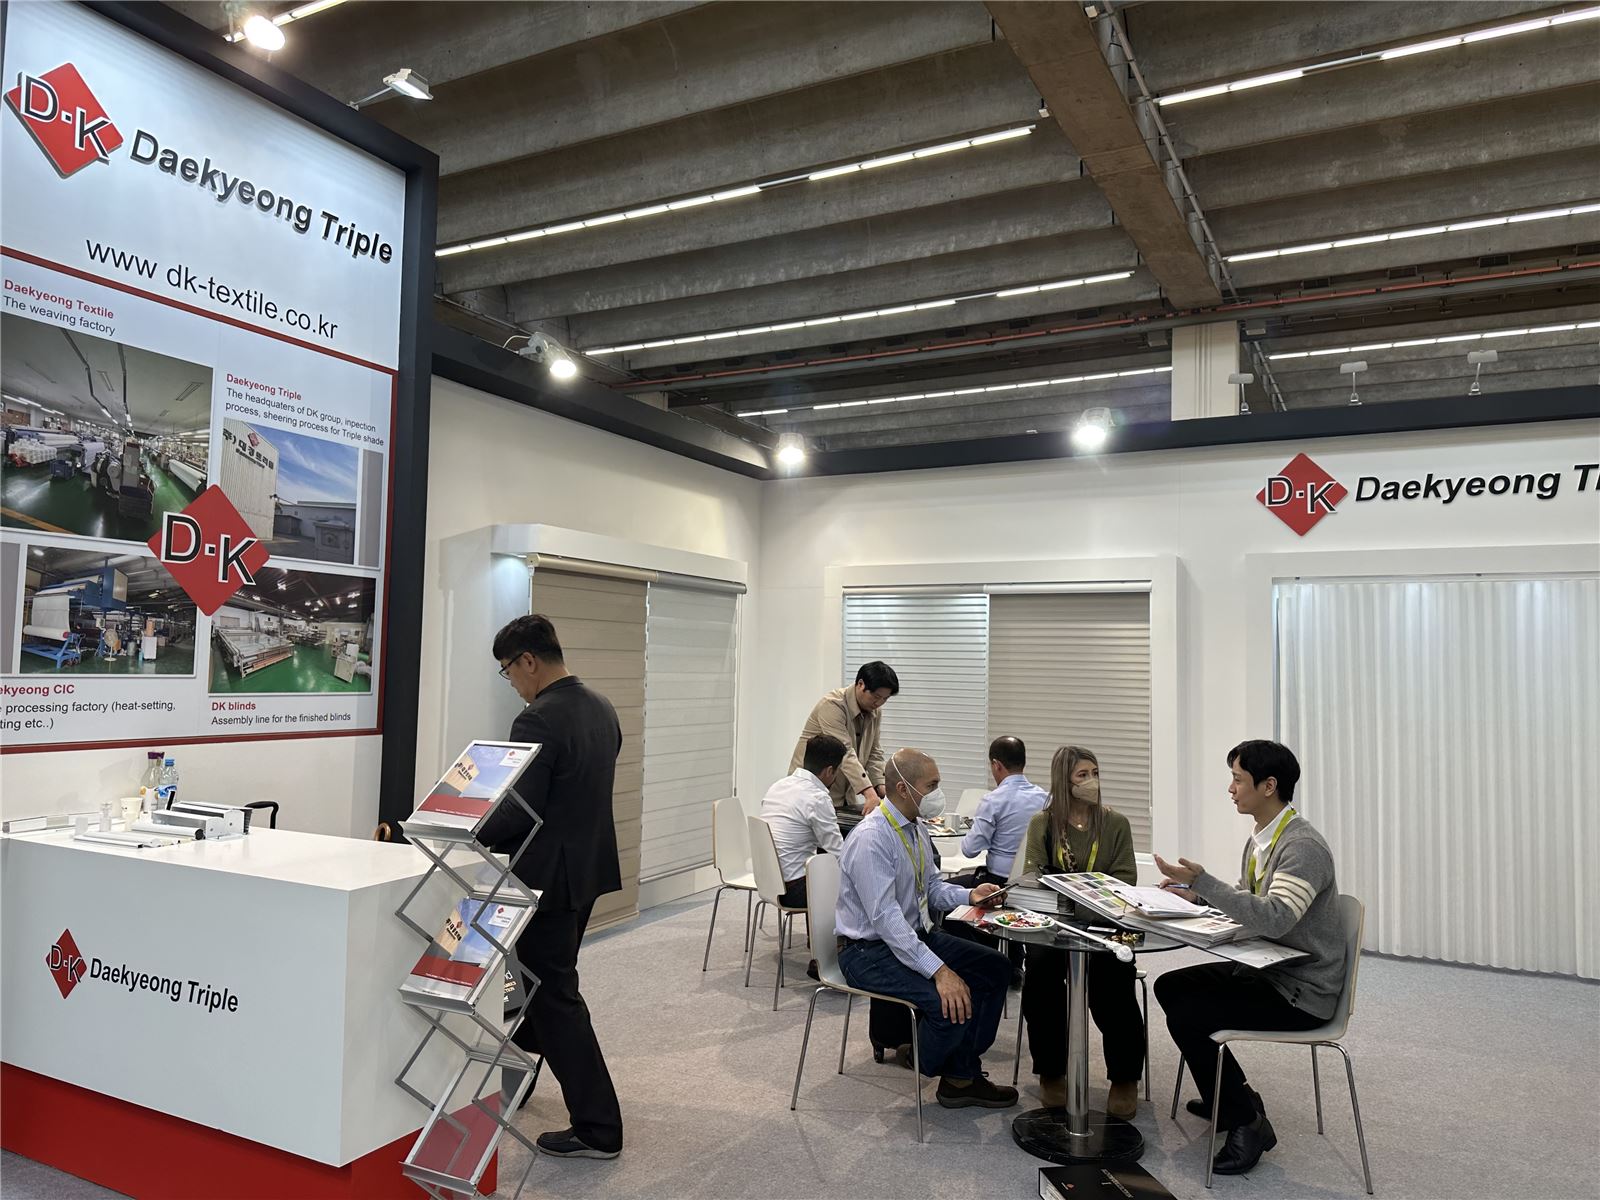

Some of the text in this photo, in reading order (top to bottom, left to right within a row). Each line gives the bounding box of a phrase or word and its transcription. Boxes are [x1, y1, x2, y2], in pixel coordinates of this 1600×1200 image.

[130, 129, 394, 264] Daekyeong Triple
[4, 279, 114, 319] Daekyeong Textile
[86, 239, 338, 340] www dk-textile.co.kr
[4, 295, 116, 337] The weaving factory
[226, 373, 301, 401] Daekyeong Triple
[226, 387, 243, 400] The
[245, 394, 295, 413] headquaters
[296, 406, 305, 415] of
[306, 407, 319, 419] DK
[319, 412, 343, 426] group,
[225, 402, 384, 447] process, sheering process for Triple shade
[1355, 473, 1561, 503] Daekyeong
[53, 684, 75, 695] CIC
[211, 702, 256, 711] DK blinds
[5, 702, 69, 716] processing
[72, 701, 108, 714] factory
[24, 718, 54, 730] etc..)
[211, 712, 351, 726] Assembly line for the finished blinds
[90, 958, 239, 1013] Daekyeong Triple
